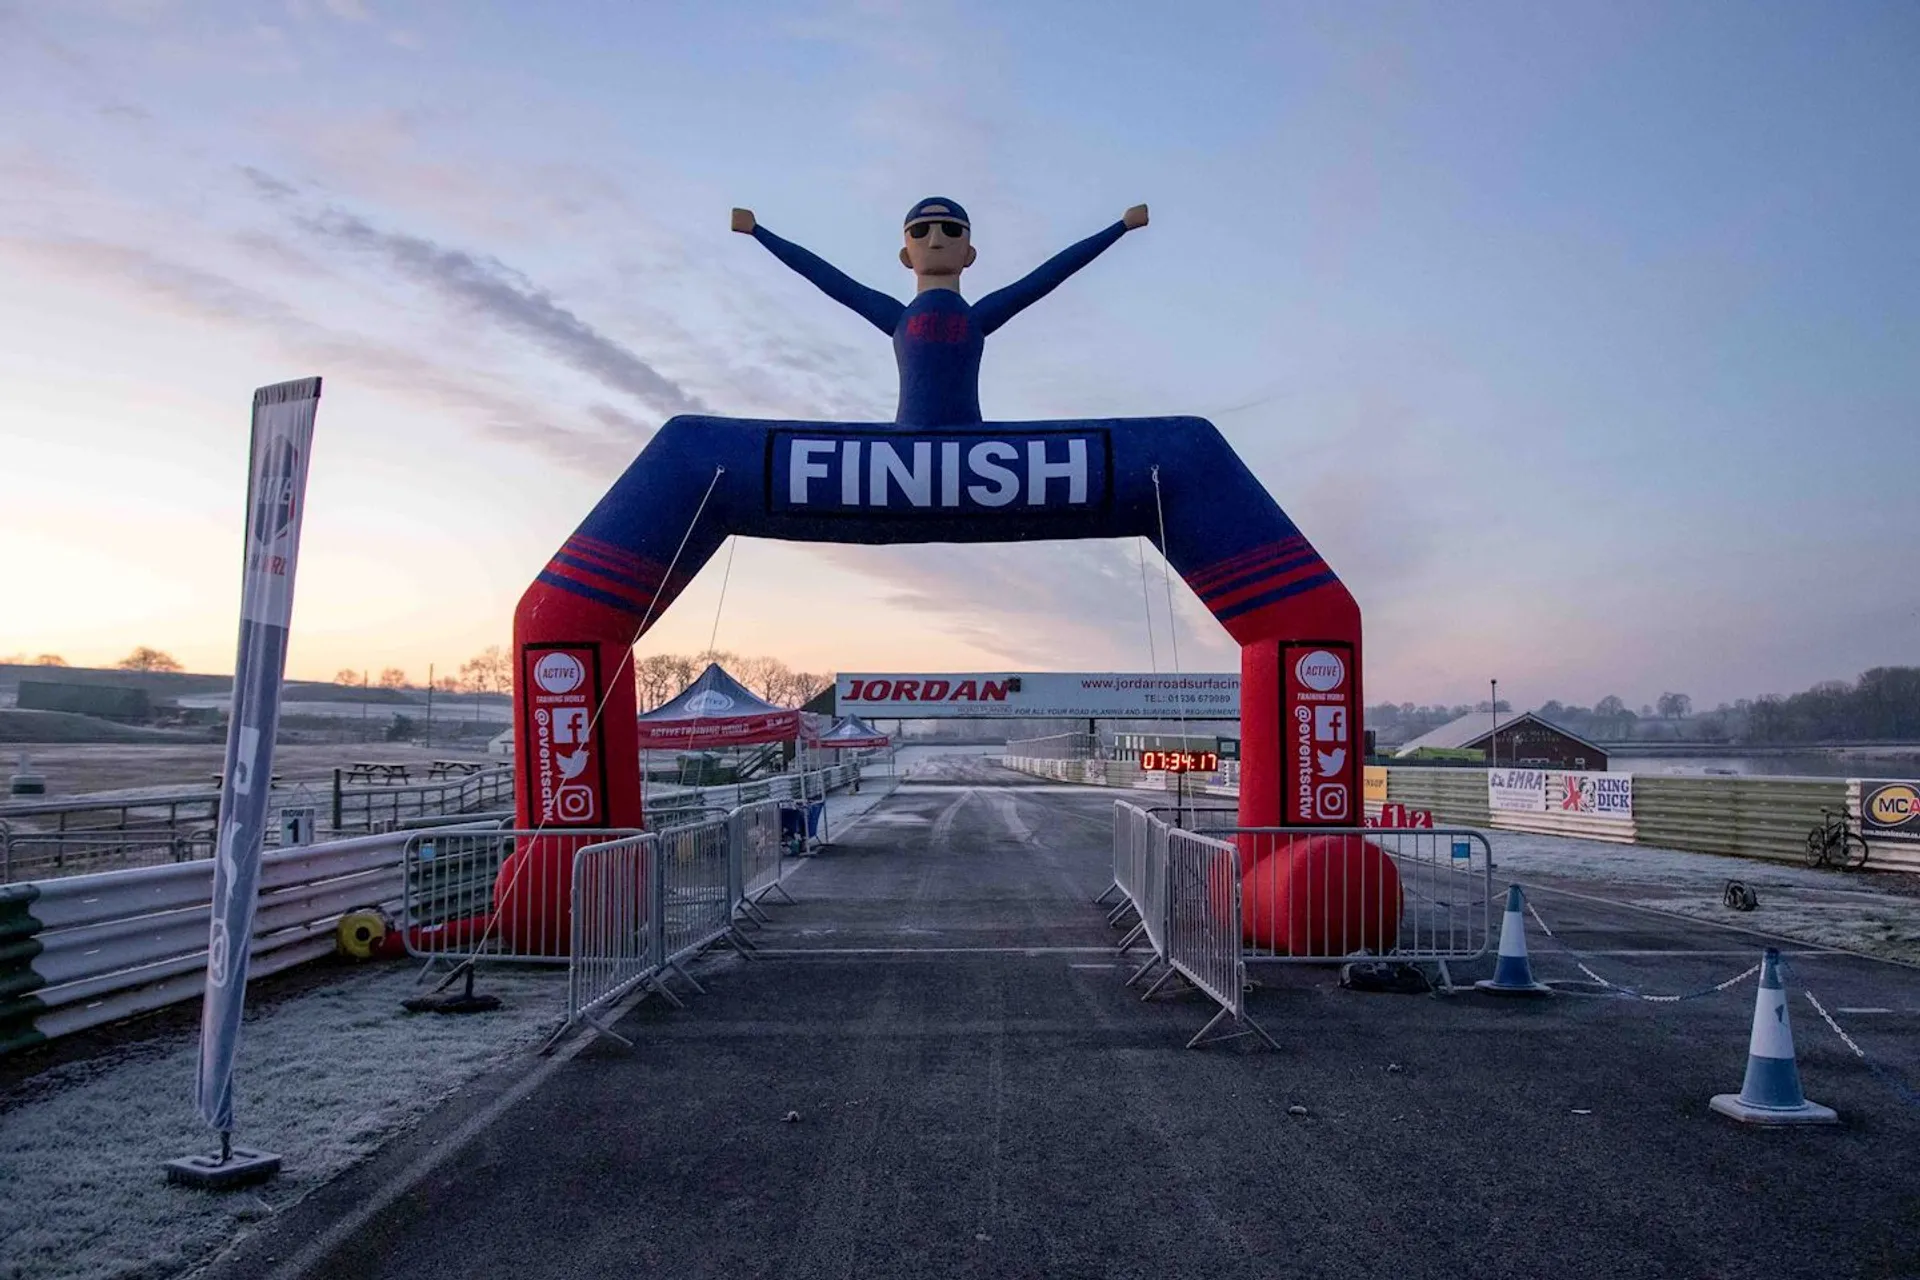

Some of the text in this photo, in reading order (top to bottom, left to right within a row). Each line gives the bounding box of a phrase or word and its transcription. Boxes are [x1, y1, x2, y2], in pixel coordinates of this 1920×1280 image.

[789, 438, 1088, 507] FINISH
[543, 667, 575, 679] ACTIVE
[1306, 664, 1337, 677] ACTIVE
[841, 679, 1010, 702] JORDAN
[1144, 694, 1165, 703] TEL:
[1124, 707, 1141, 716] AND
[651, 723, 749, 737] ACTIVE TRAINING WORLD
[534, 707, 553, 821] @eventsatw
[1143, 752, 1218, 770] 07:34:17
[1294, 705, 1314, 819] @eventsatw
[1507, 770, 1543, 790] EMRA
[1598, 779, 1629, 793] KING
[1598, 793, 1629, 808] DICK
[1388, 805, 1398, 827] 1
[1415, 812, 1426, 828] 2
[287, 818, 299, 843] 1
